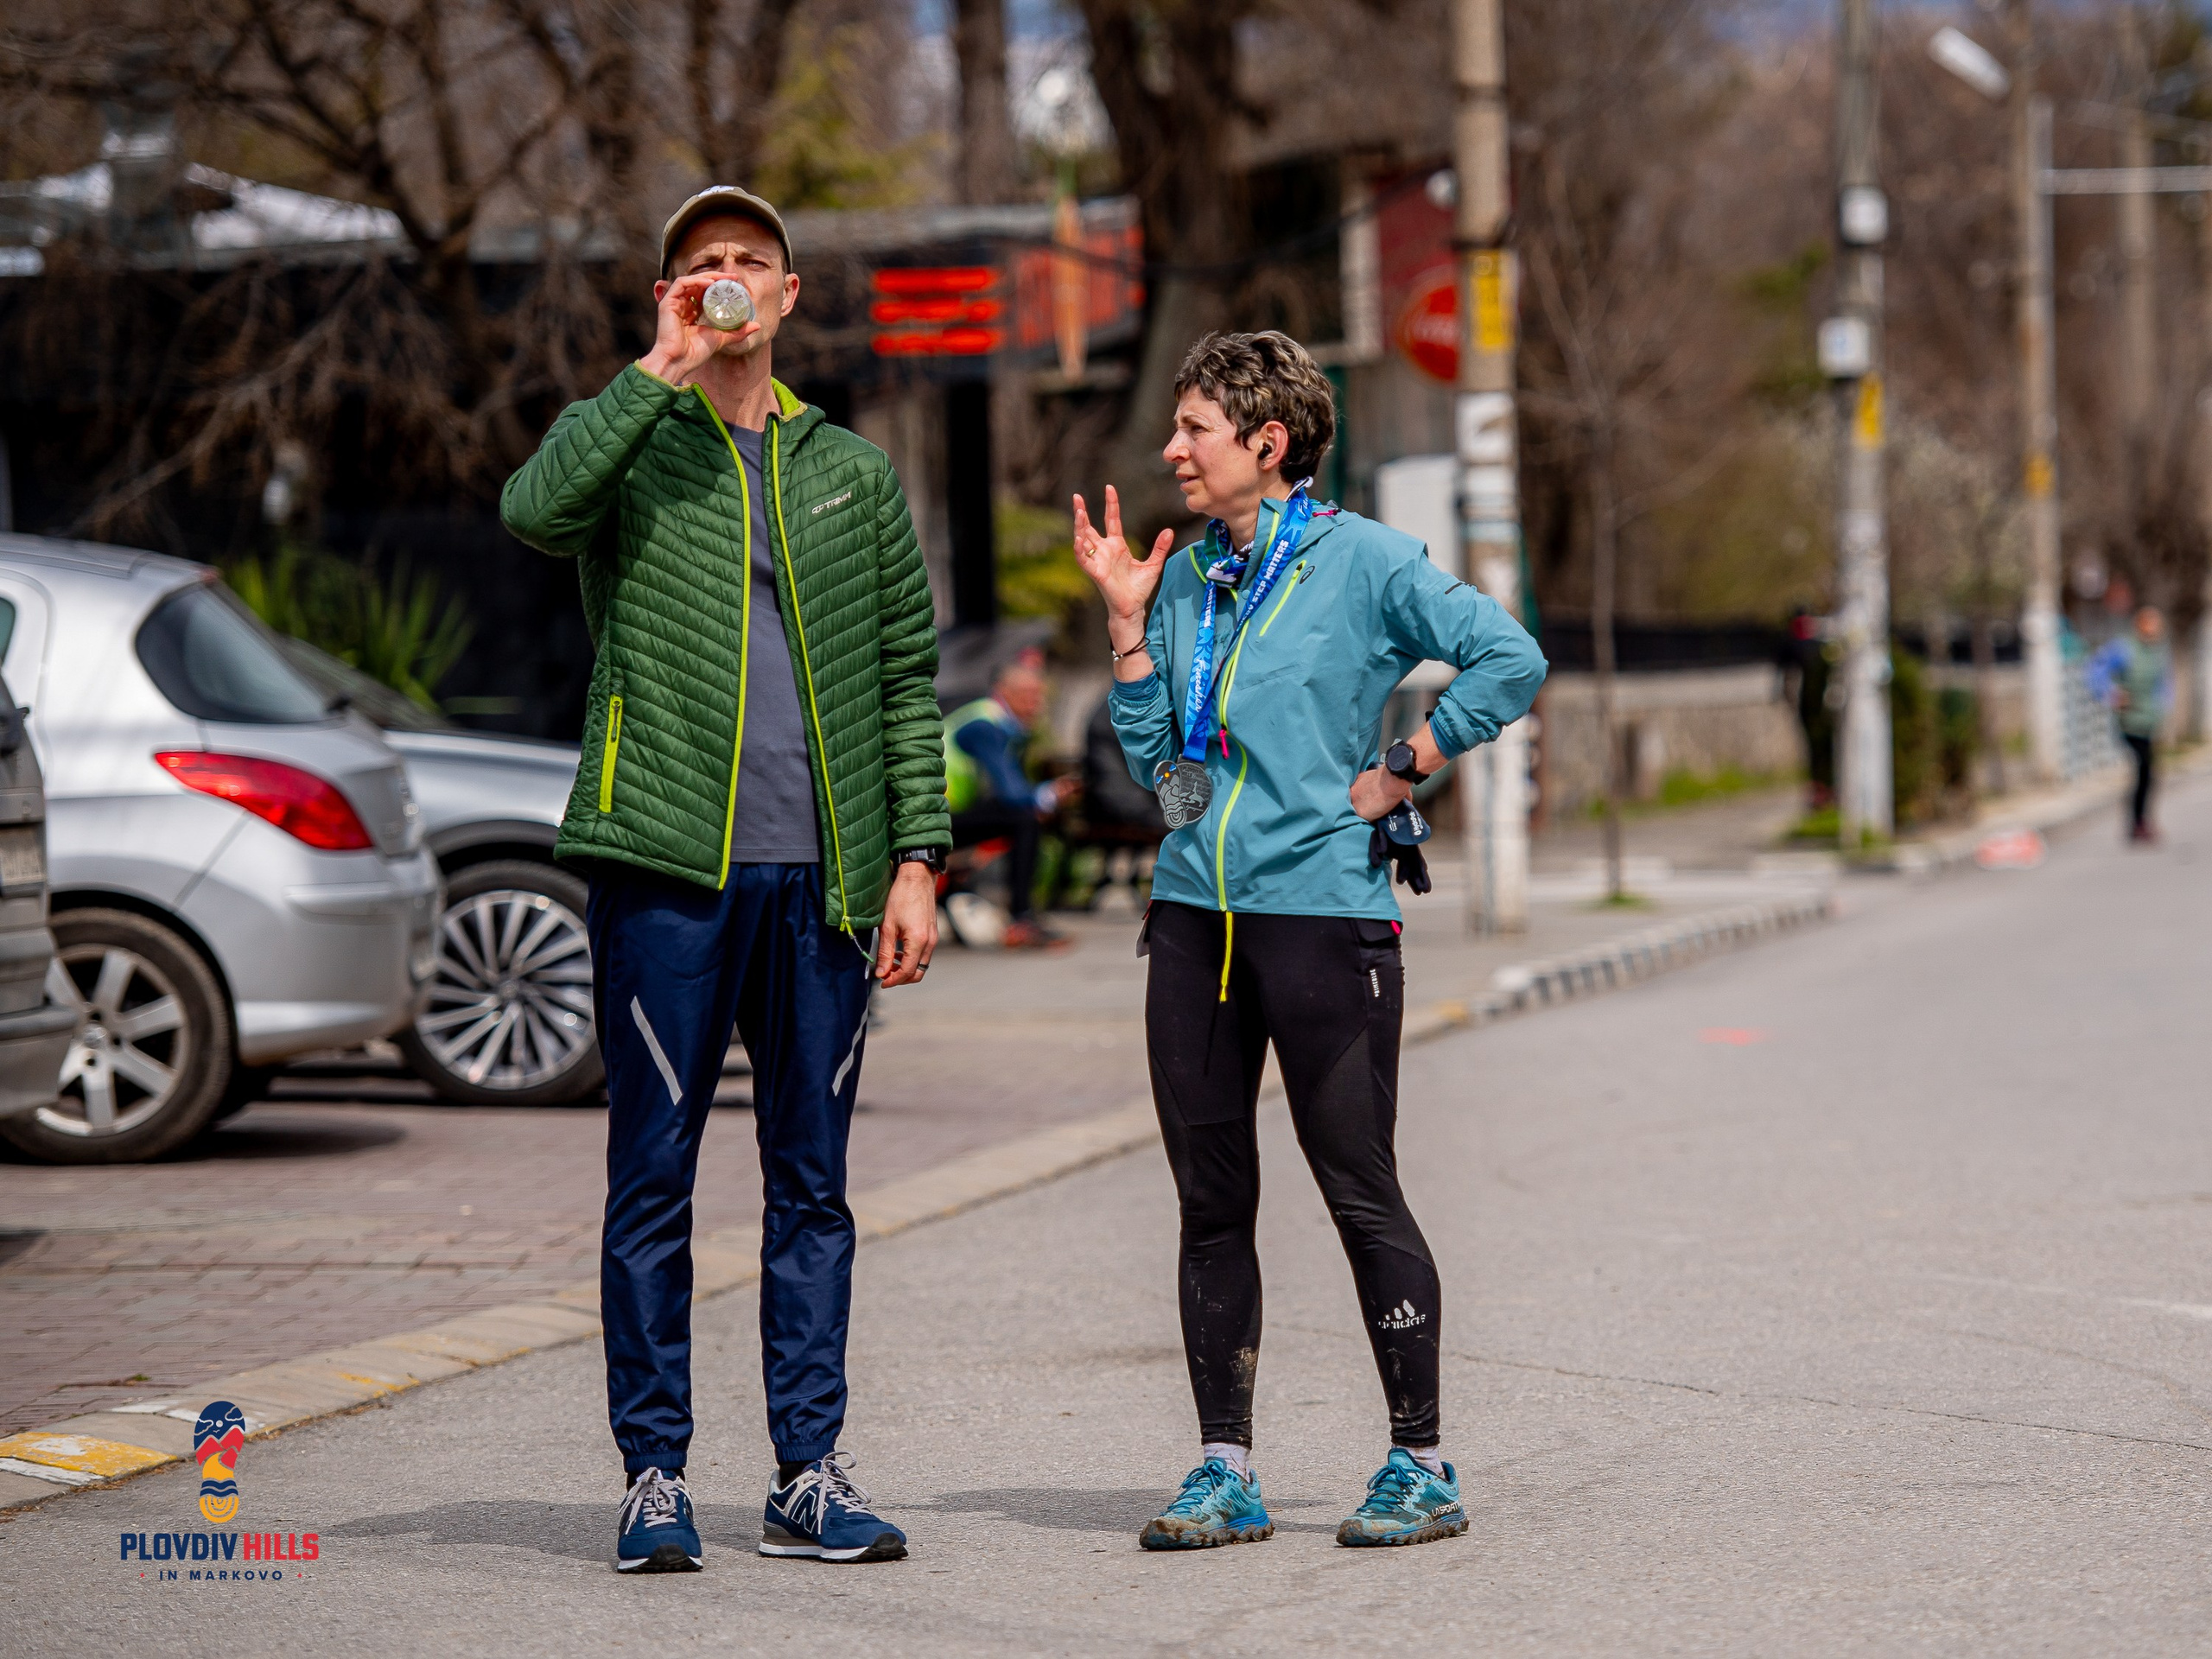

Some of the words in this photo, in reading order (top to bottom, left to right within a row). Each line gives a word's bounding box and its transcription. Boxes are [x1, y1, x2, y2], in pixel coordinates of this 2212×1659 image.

[824, 491, 851, 508] TRIMM
[1252, 579, 1267, 603] STEP
[1265, 539, 1289, 580] MATTERS
[1194, 658, 1206, 713] Finisher
